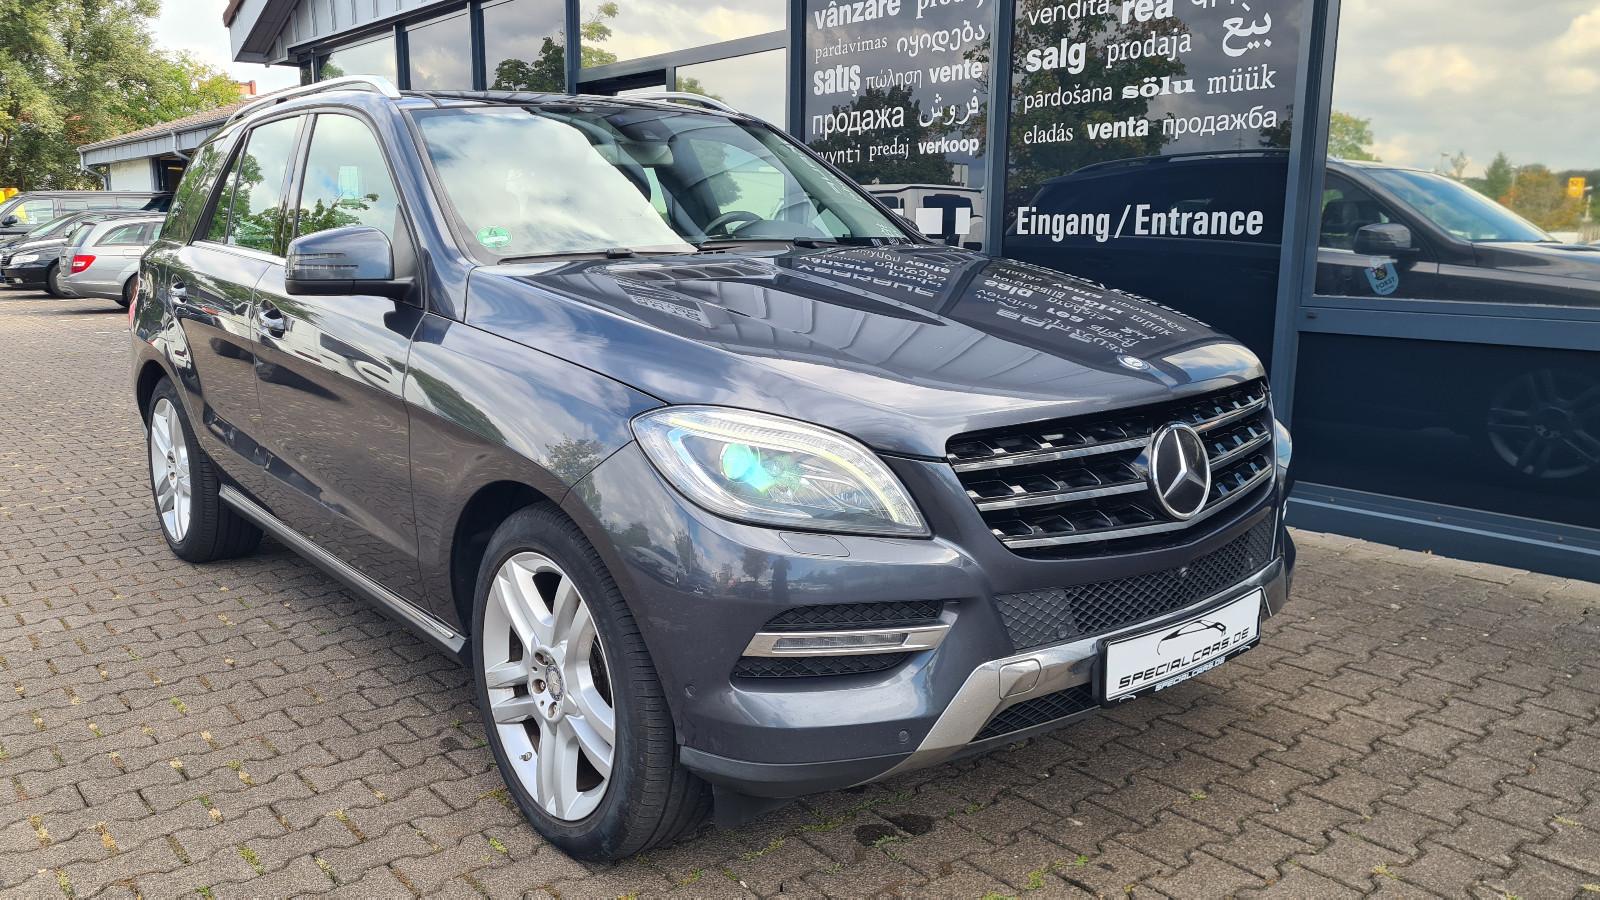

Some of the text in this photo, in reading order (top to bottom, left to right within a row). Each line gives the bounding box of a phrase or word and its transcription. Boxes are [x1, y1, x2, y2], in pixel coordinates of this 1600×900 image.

[815, 0, 901, 30] vânzare
[1027, 0, 1110, 26] vendita
[1121, 0, 1174, 24] rea
[815, 36, 888, 64] pardavimas
[897, 20, 986, 57] იყიდება
[1026, 28, 1192, 75] salg prodaja
[814, 64, 861, 96] satış
[866, 69, 922, 91] πώληση
[929, 59, 983, 84] vente
[1024, 63, 1276, 115] pārdošana sölu müük
[812, 105, 904, 140] продажа
[919, 88, 980, 127] فروش
[1162, 105, 1278, 140] продажба
[1024, 116, 1149, 145] eladás venta
[869, 137, 910, 162] predaj
[918, 136, 980, 156] verkoop
[1118, 627, 1250, 690] SPECIALCARS.DE
